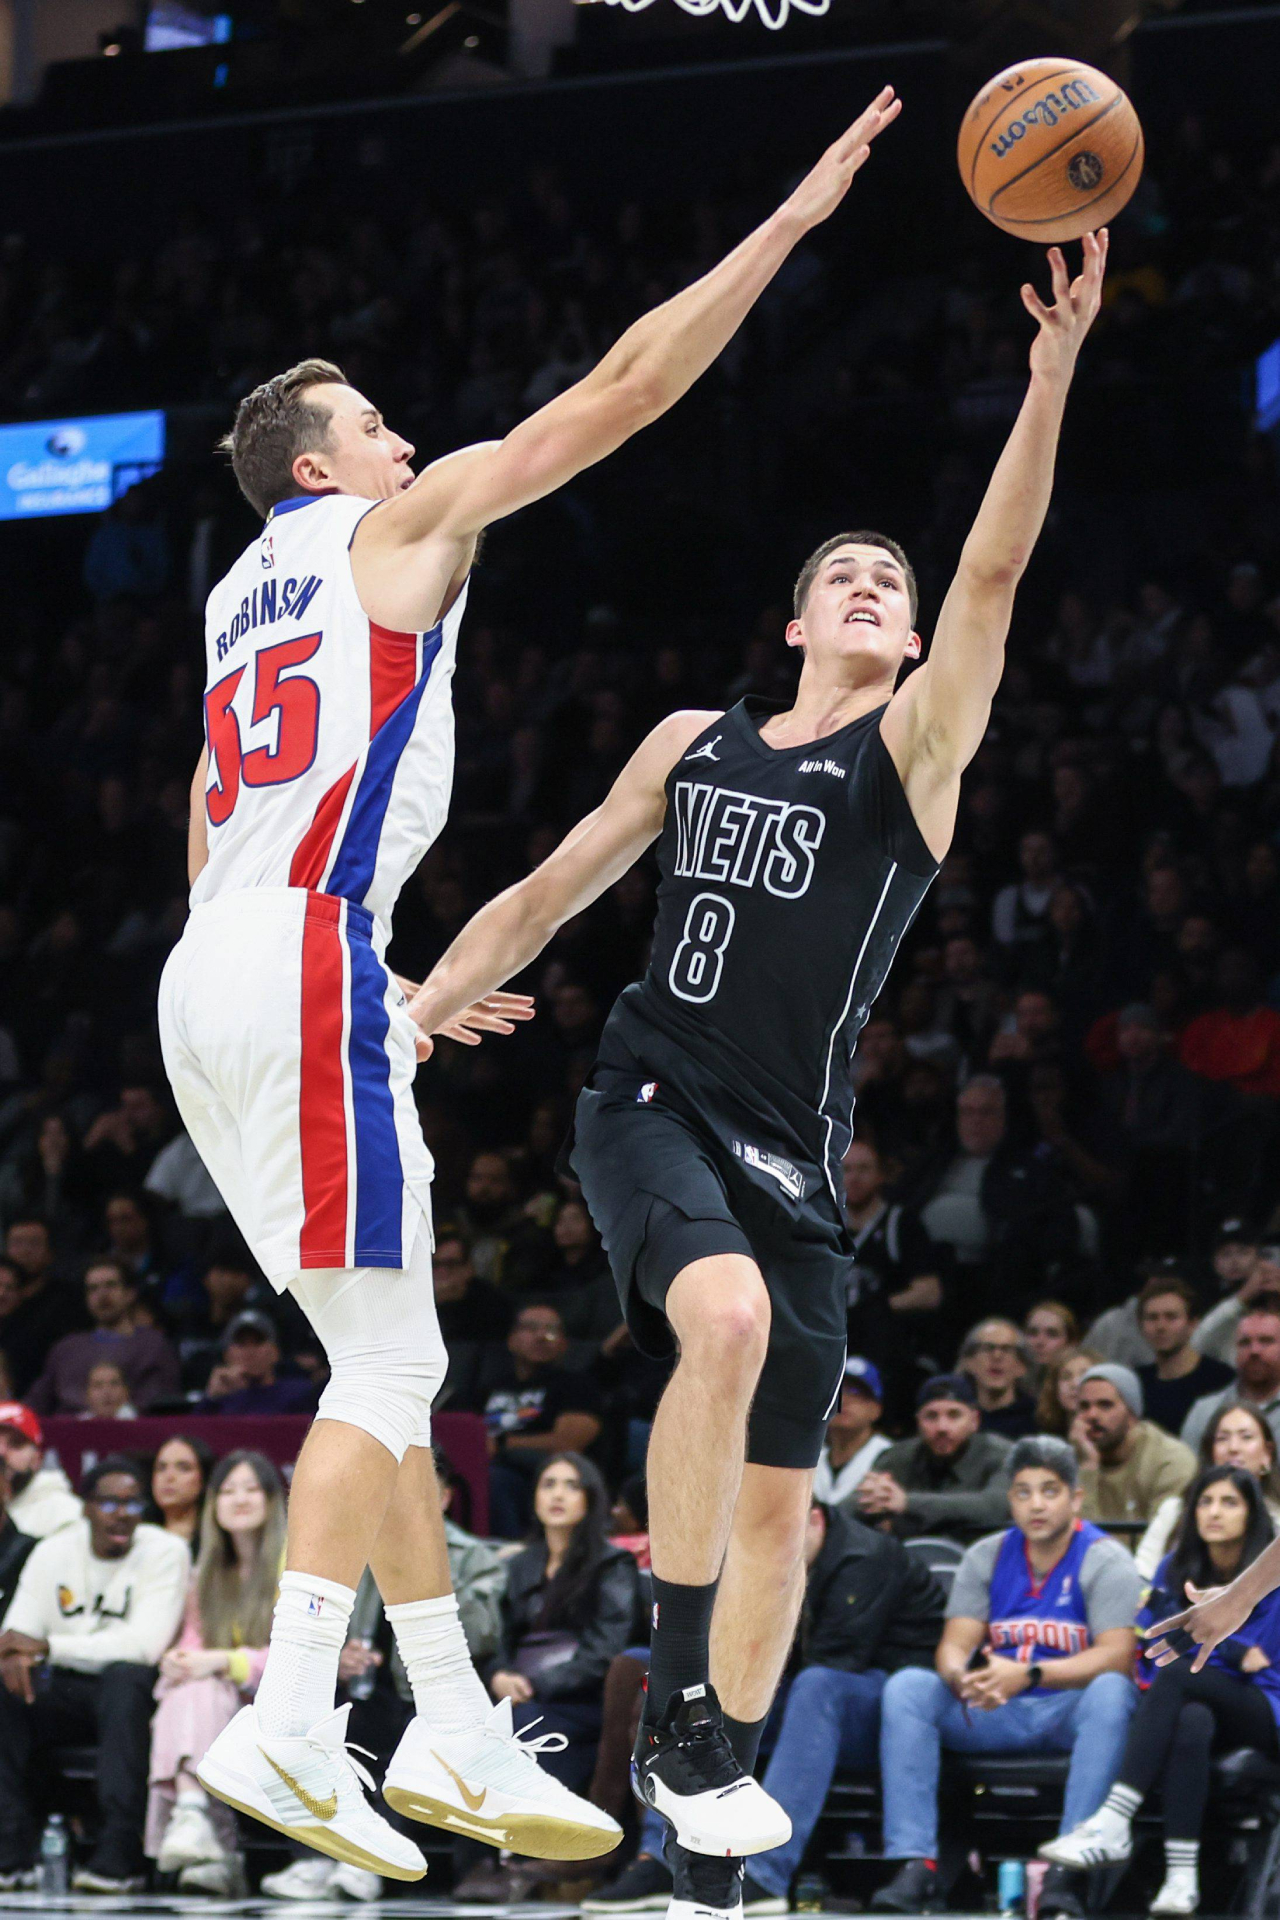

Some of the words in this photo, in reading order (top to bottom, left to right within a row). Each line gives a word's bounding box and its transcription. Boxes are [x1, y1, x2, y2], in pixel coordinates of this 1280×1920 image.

[990, 79, 1099, 159] Wilson
[216, 575, 323, 663] ROBINSN
[203, 630, 323, 827] 55
[798, 760, 815, 773] All
[823, 759, 846, 779] Won
[674, 781, 826, 899] NETS
[668, 892, 736, 1004] 8
[990, 1617, 1089, 1655] ETROIT
